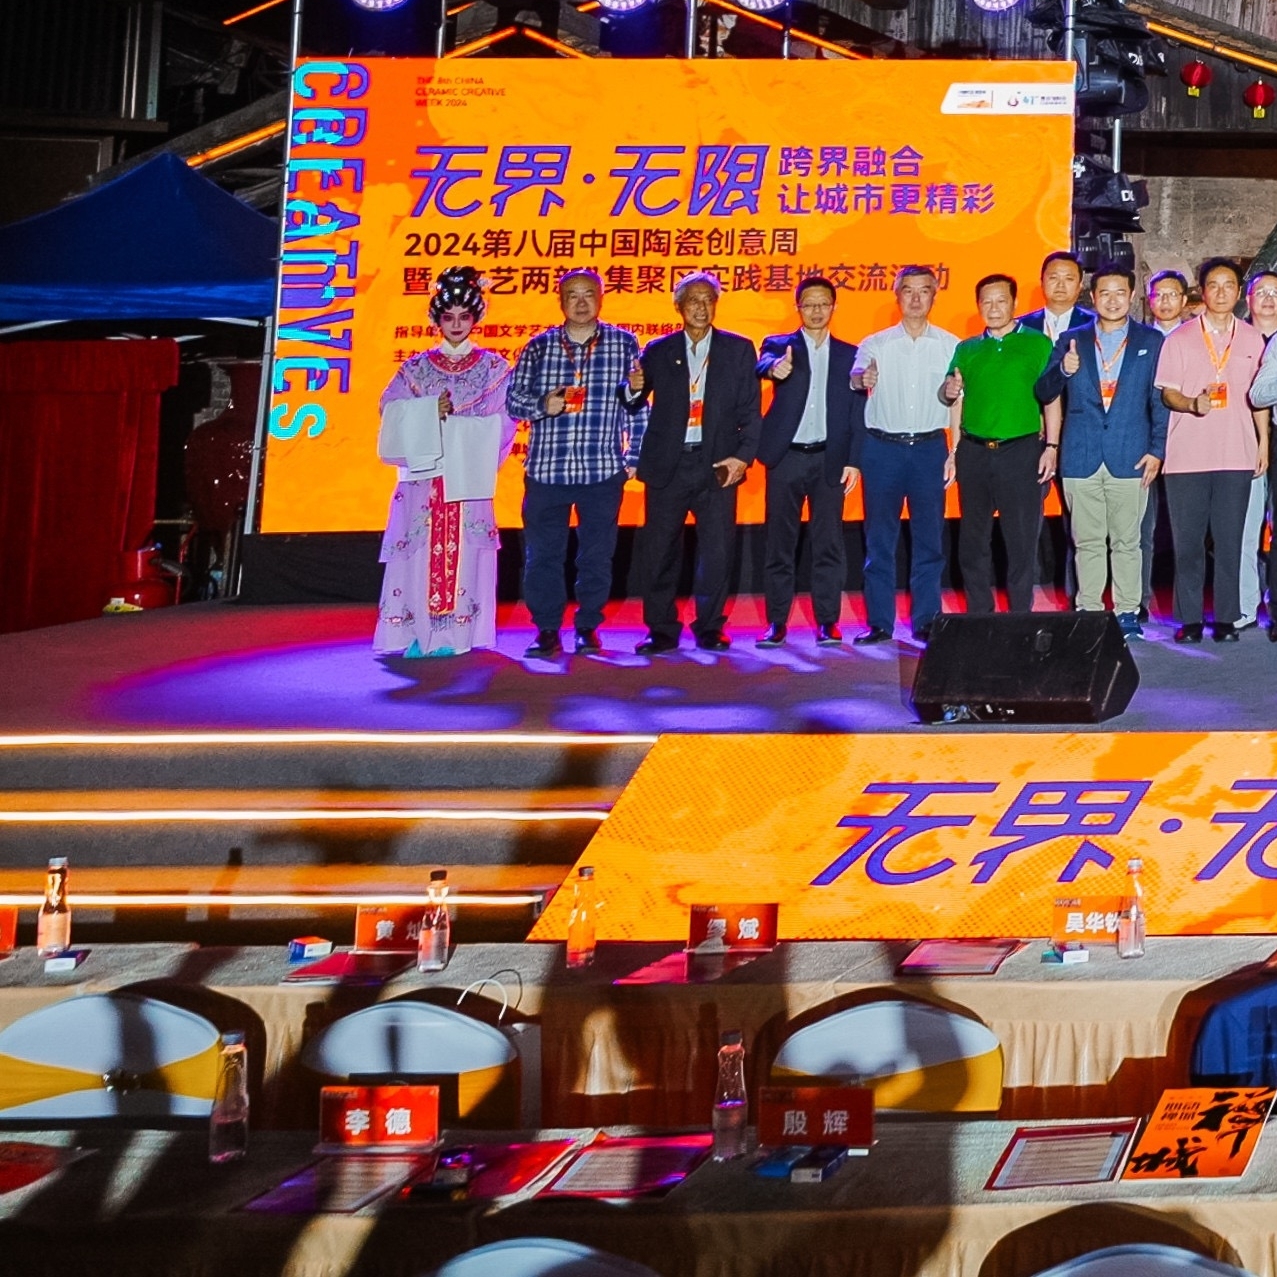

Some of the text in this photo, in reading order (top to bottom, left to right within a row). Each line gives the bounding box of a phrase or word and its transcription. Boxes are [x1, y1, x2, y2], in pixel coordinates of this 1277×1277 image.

[779, 145, 925, 178] 跨界融合
[779, 181, 996, 215] 让城市更精彩
[404, 228, 798, 258] 2024第八届中国陶瓷创意周
[344, 1108, 412, 1136] 李德
[782, 1109, 849, 1136] 殷辉
